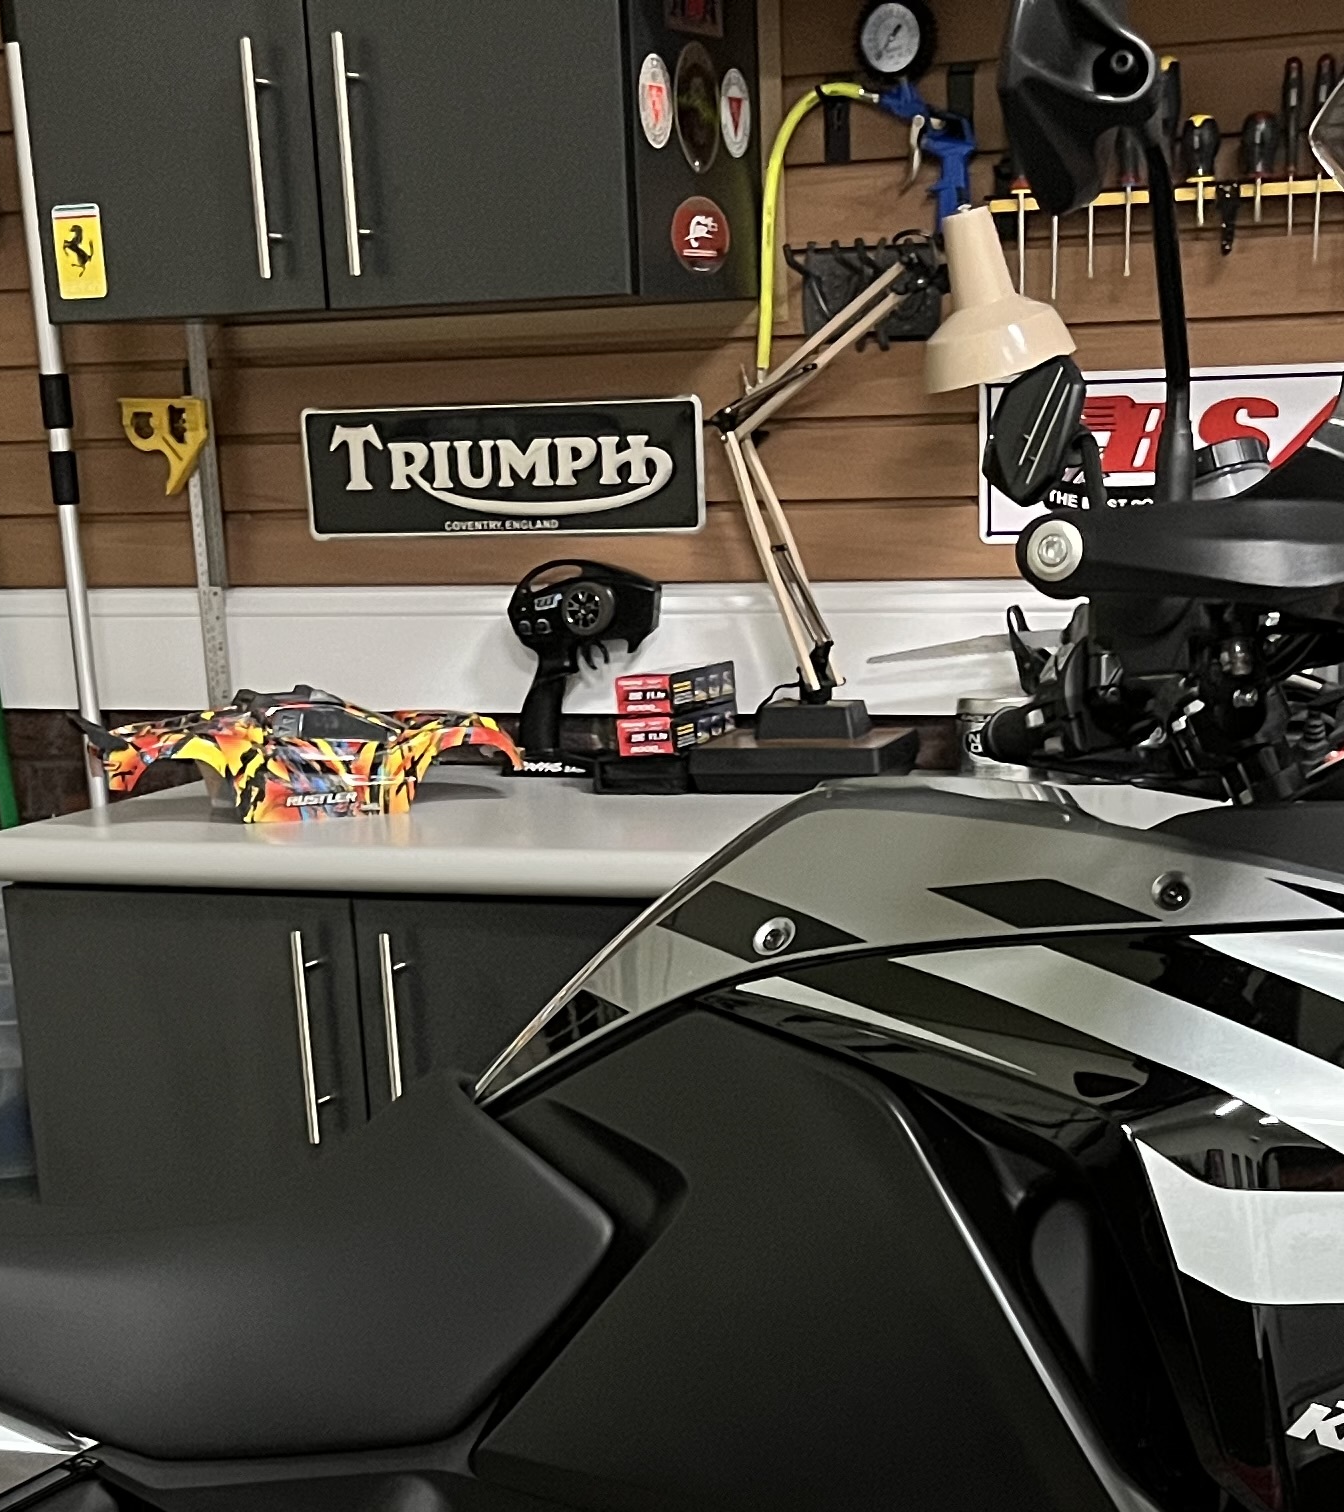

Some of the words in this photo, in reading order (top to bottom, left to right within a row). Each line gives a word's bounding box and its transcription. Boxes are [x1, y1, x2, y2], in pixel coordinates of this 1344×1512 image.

[330, 424, 674, 516] TRIUMPH
[505, 518, 560, 531] ENGLAND
[286, 791, 357, 807] RUSTLER
